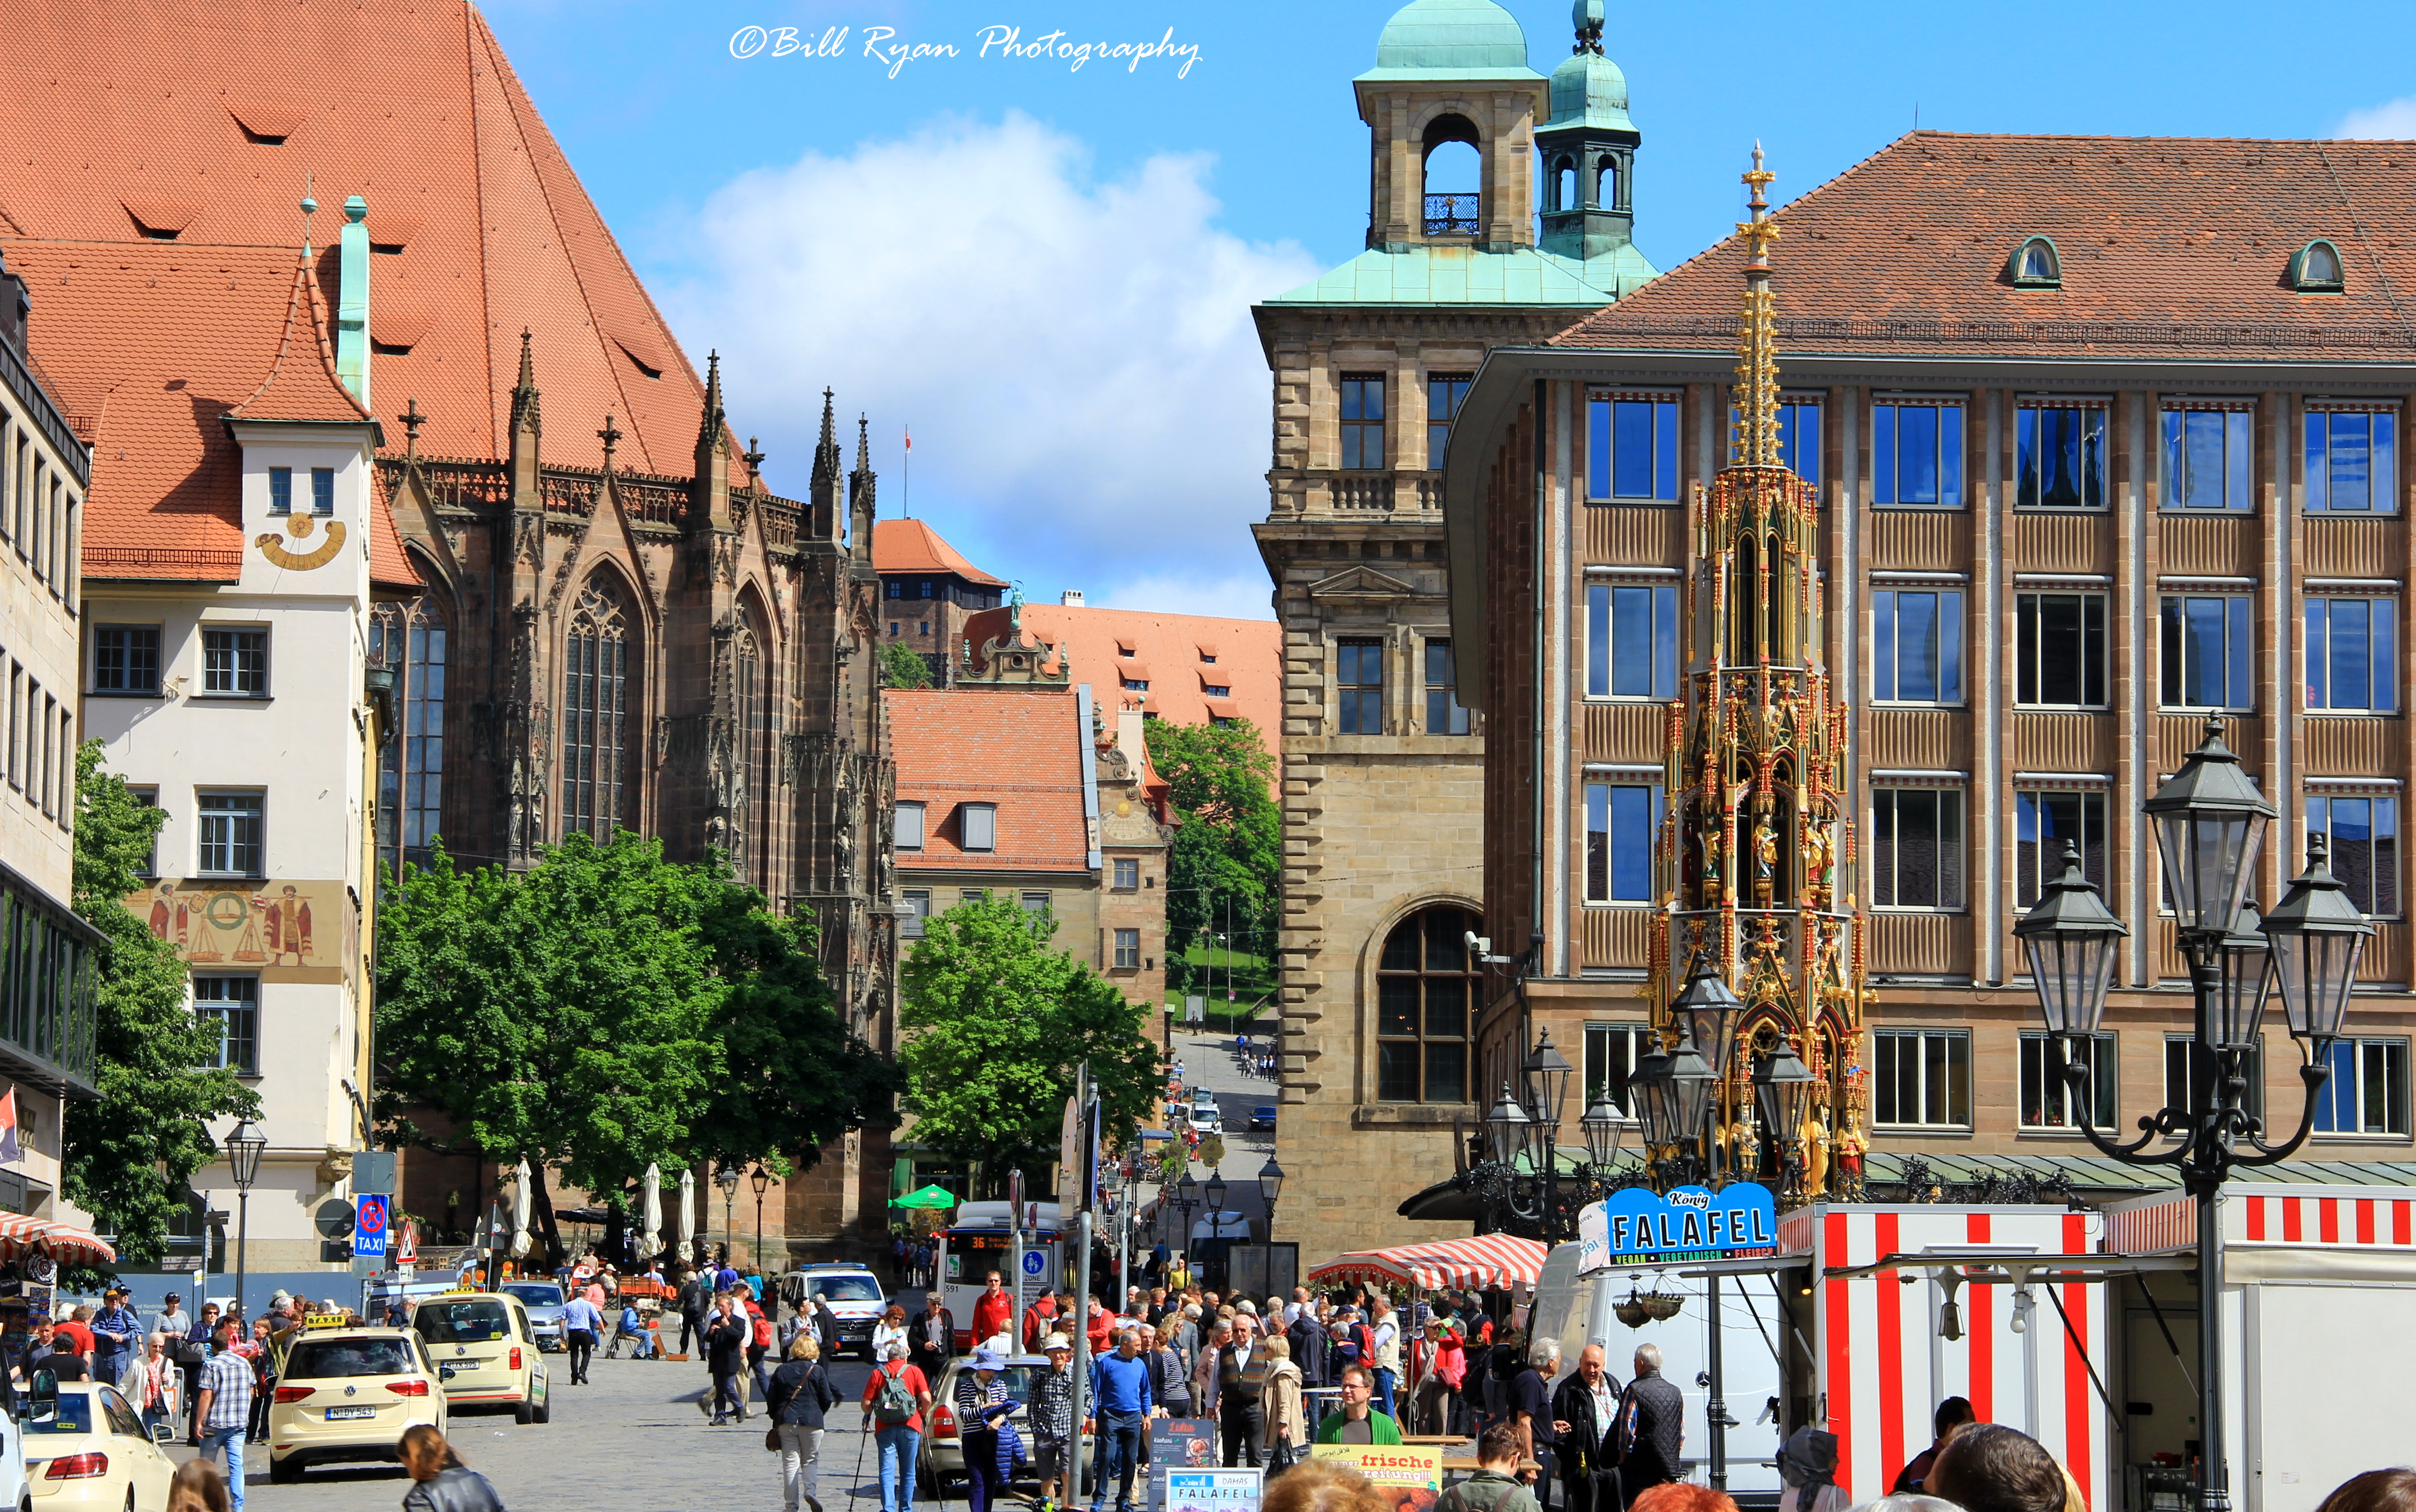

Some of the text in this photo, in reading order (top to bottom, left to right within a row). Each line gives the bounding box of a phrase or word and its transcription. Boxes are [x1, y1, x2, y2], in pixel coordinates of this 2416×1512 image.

[1669, 1191, 1709, 1210] König
[1613, 1209, 1770, 1250] FALAFEL
[357, 1237, 383, 1251] TAXI
[972, 1237, 985, 1248] 36
[1616, 1254, 1646, 1264] VEGAN
[1659, 1250, 1722, 1262] VEGETARISCH
[344, 1408, 355, 1416] DY
[357, 1407, 372, 1415] 543
[1361, 1454, 1433, 1468] frische
[1222, 1477, 1248, 1485] DAMAS
[1179, 1488, 1249, 1499] FALAFEL
